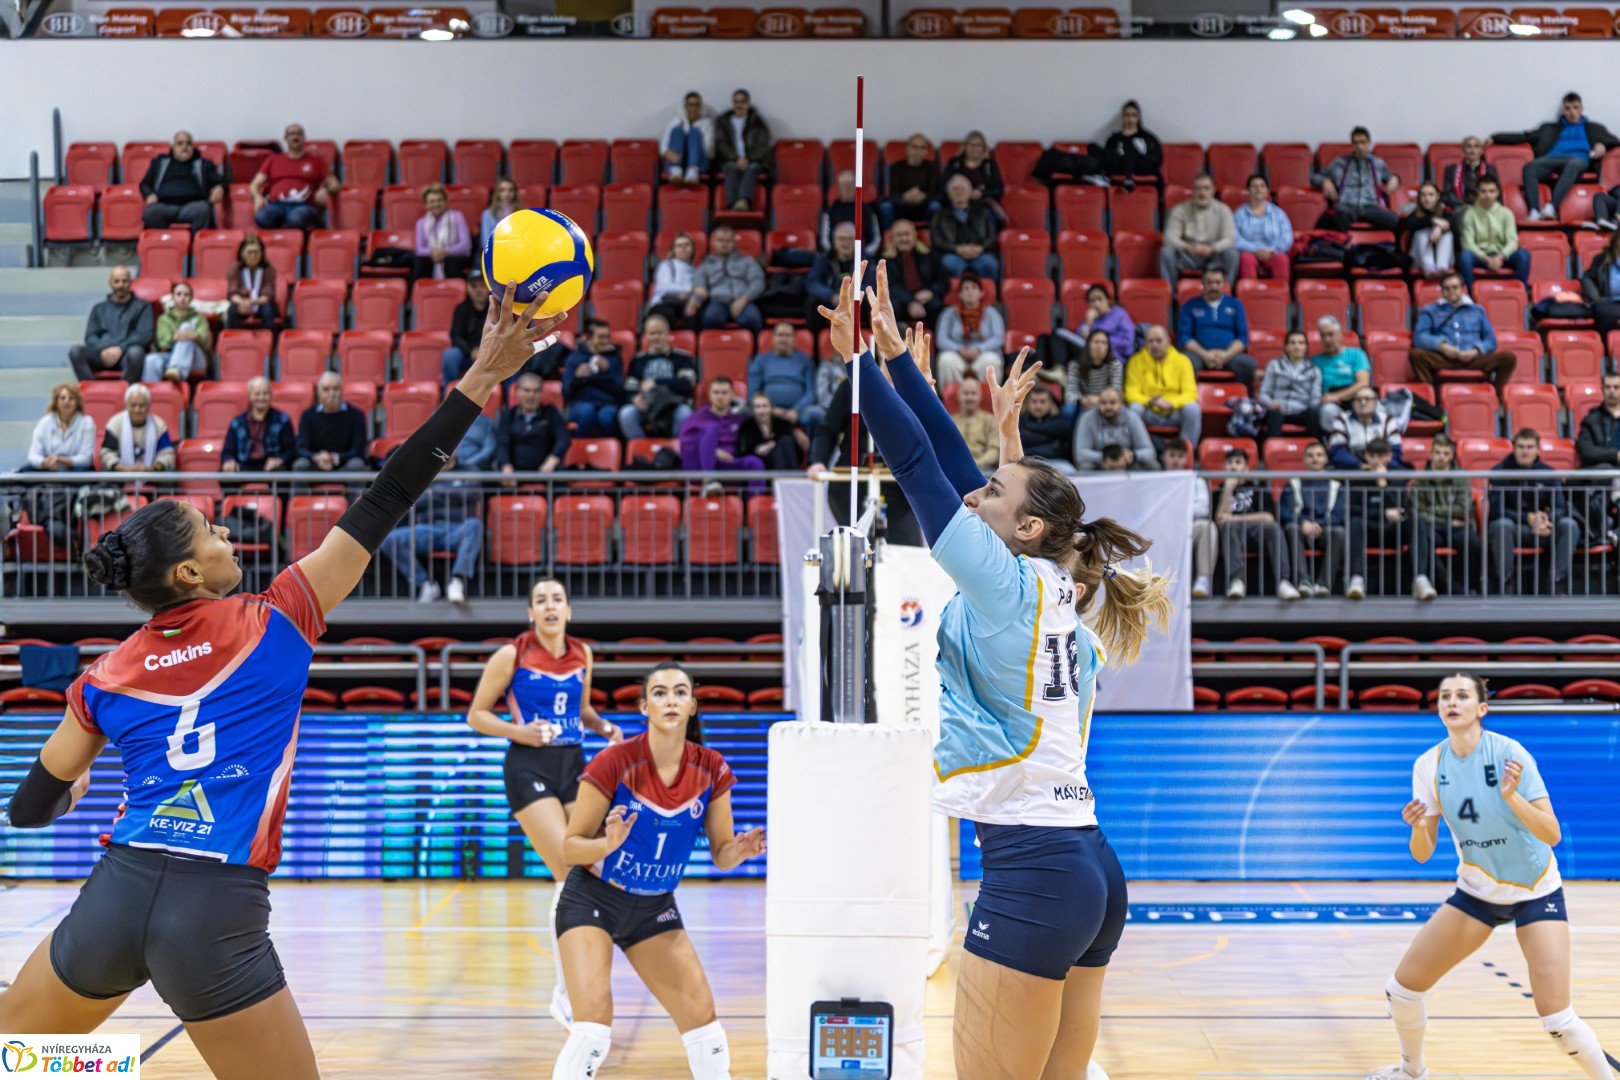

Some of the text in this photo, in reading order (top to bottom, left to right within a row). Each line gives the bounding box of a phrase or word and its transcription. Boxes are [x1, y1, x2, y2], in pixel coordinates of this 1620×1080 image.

[527, 275, 549, 292] FIVB
[144, 641, 213, 671] Calkins
[554, 692, 568, 716] 8
[166, 700, 216, 771] 6
[1458, 797, 1479, 824] 4
[149, 817, 213, 835] KE-VIZ 21
[654, 832, 668, 860] 1
[612, 849, 684, 878] FATUM
